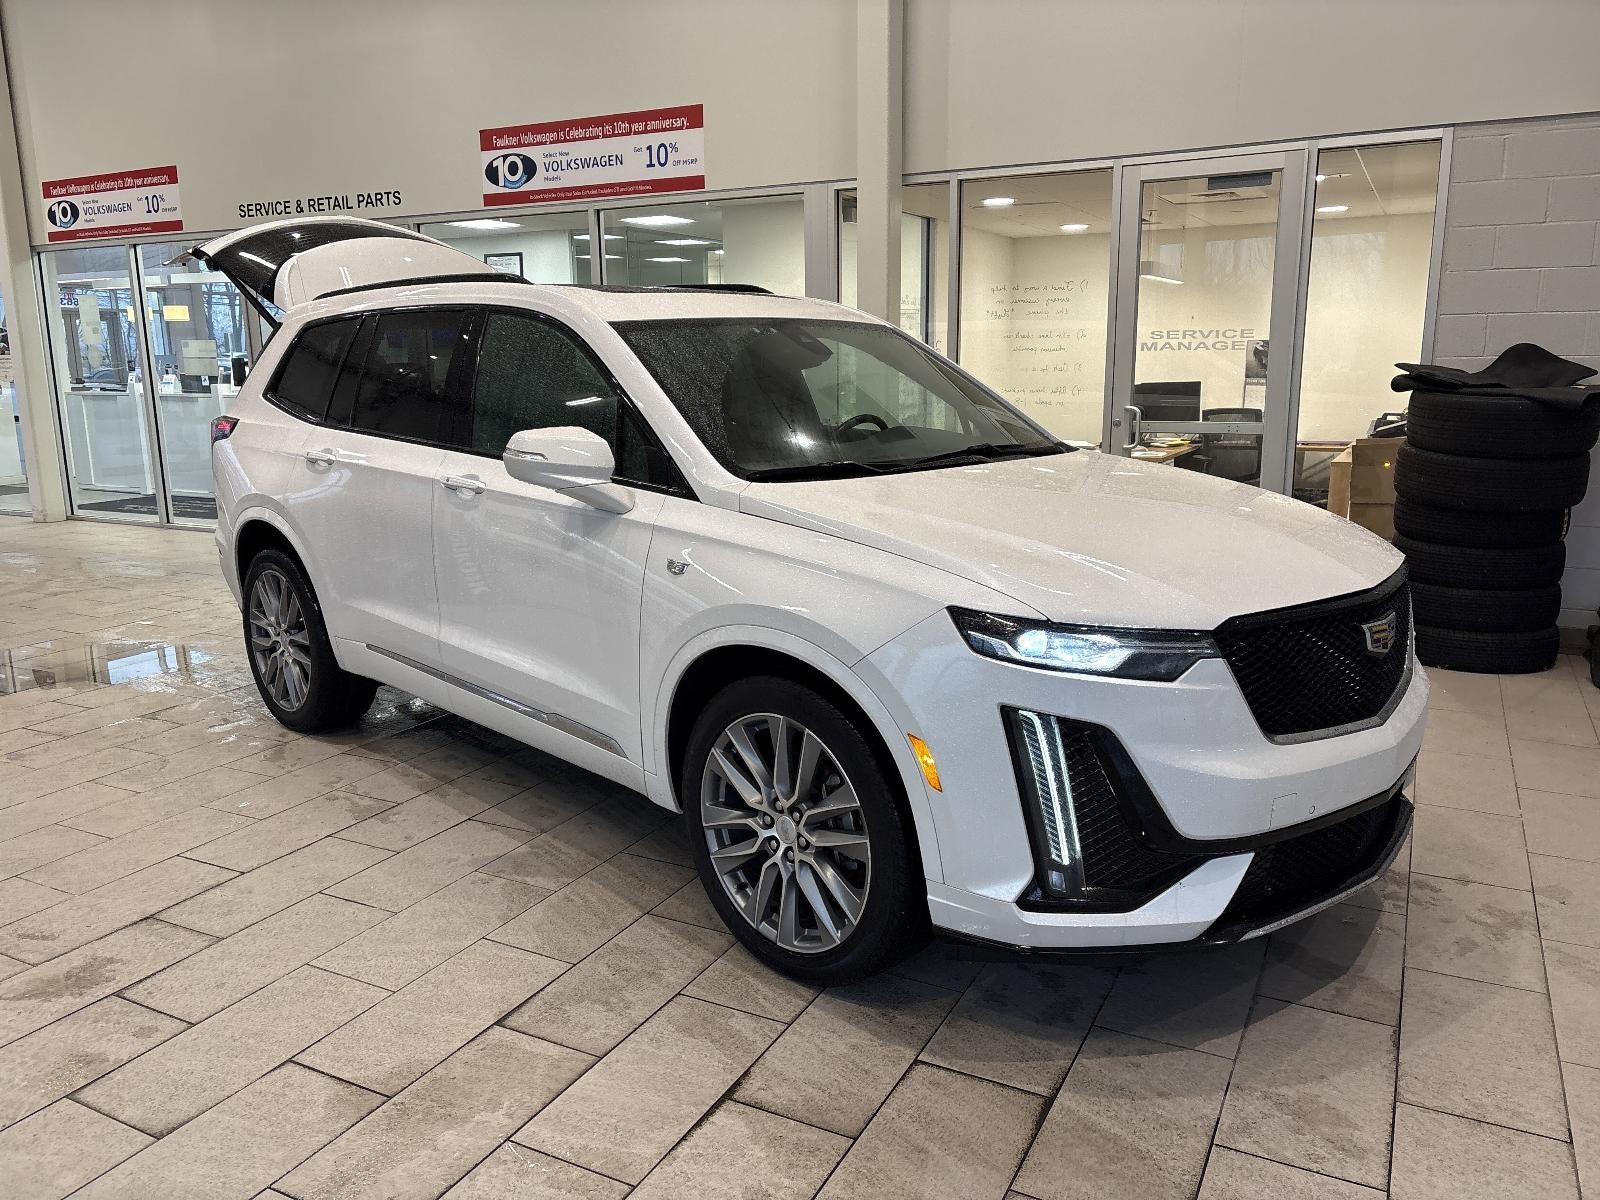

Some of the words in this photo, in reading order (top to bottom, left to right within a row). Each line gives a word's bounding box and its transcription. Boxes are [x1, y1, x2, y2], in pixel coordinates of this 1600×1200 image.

[492, 135, 520, 147] Faulkner
[520, 131, 558, 145] Volkswagen
[558, 129, 564, 140] is
[565, 124, 603, 140] Celebrating
[603, 123, 613, 135] its
[614, 121, 630, 134] 10th
[631, 121, 645, 136] year
[646, 117, 690, 130] anniversary.
[542, 151, 558, 159] Select
[543, 154, 624, 173] VOLKSWAGEN
[543, 175, 562, 183] Models
[83, 202, 132, 216] VOLKSWAGEN
[238, 200, 292, 219] SERVICE
[295, 199, 305, 214] &
[308, 195, 354, 213] RETAIL
[357, 190, 402, 209] PARTS
[1150, 328, 1255, 340] SERVICE
